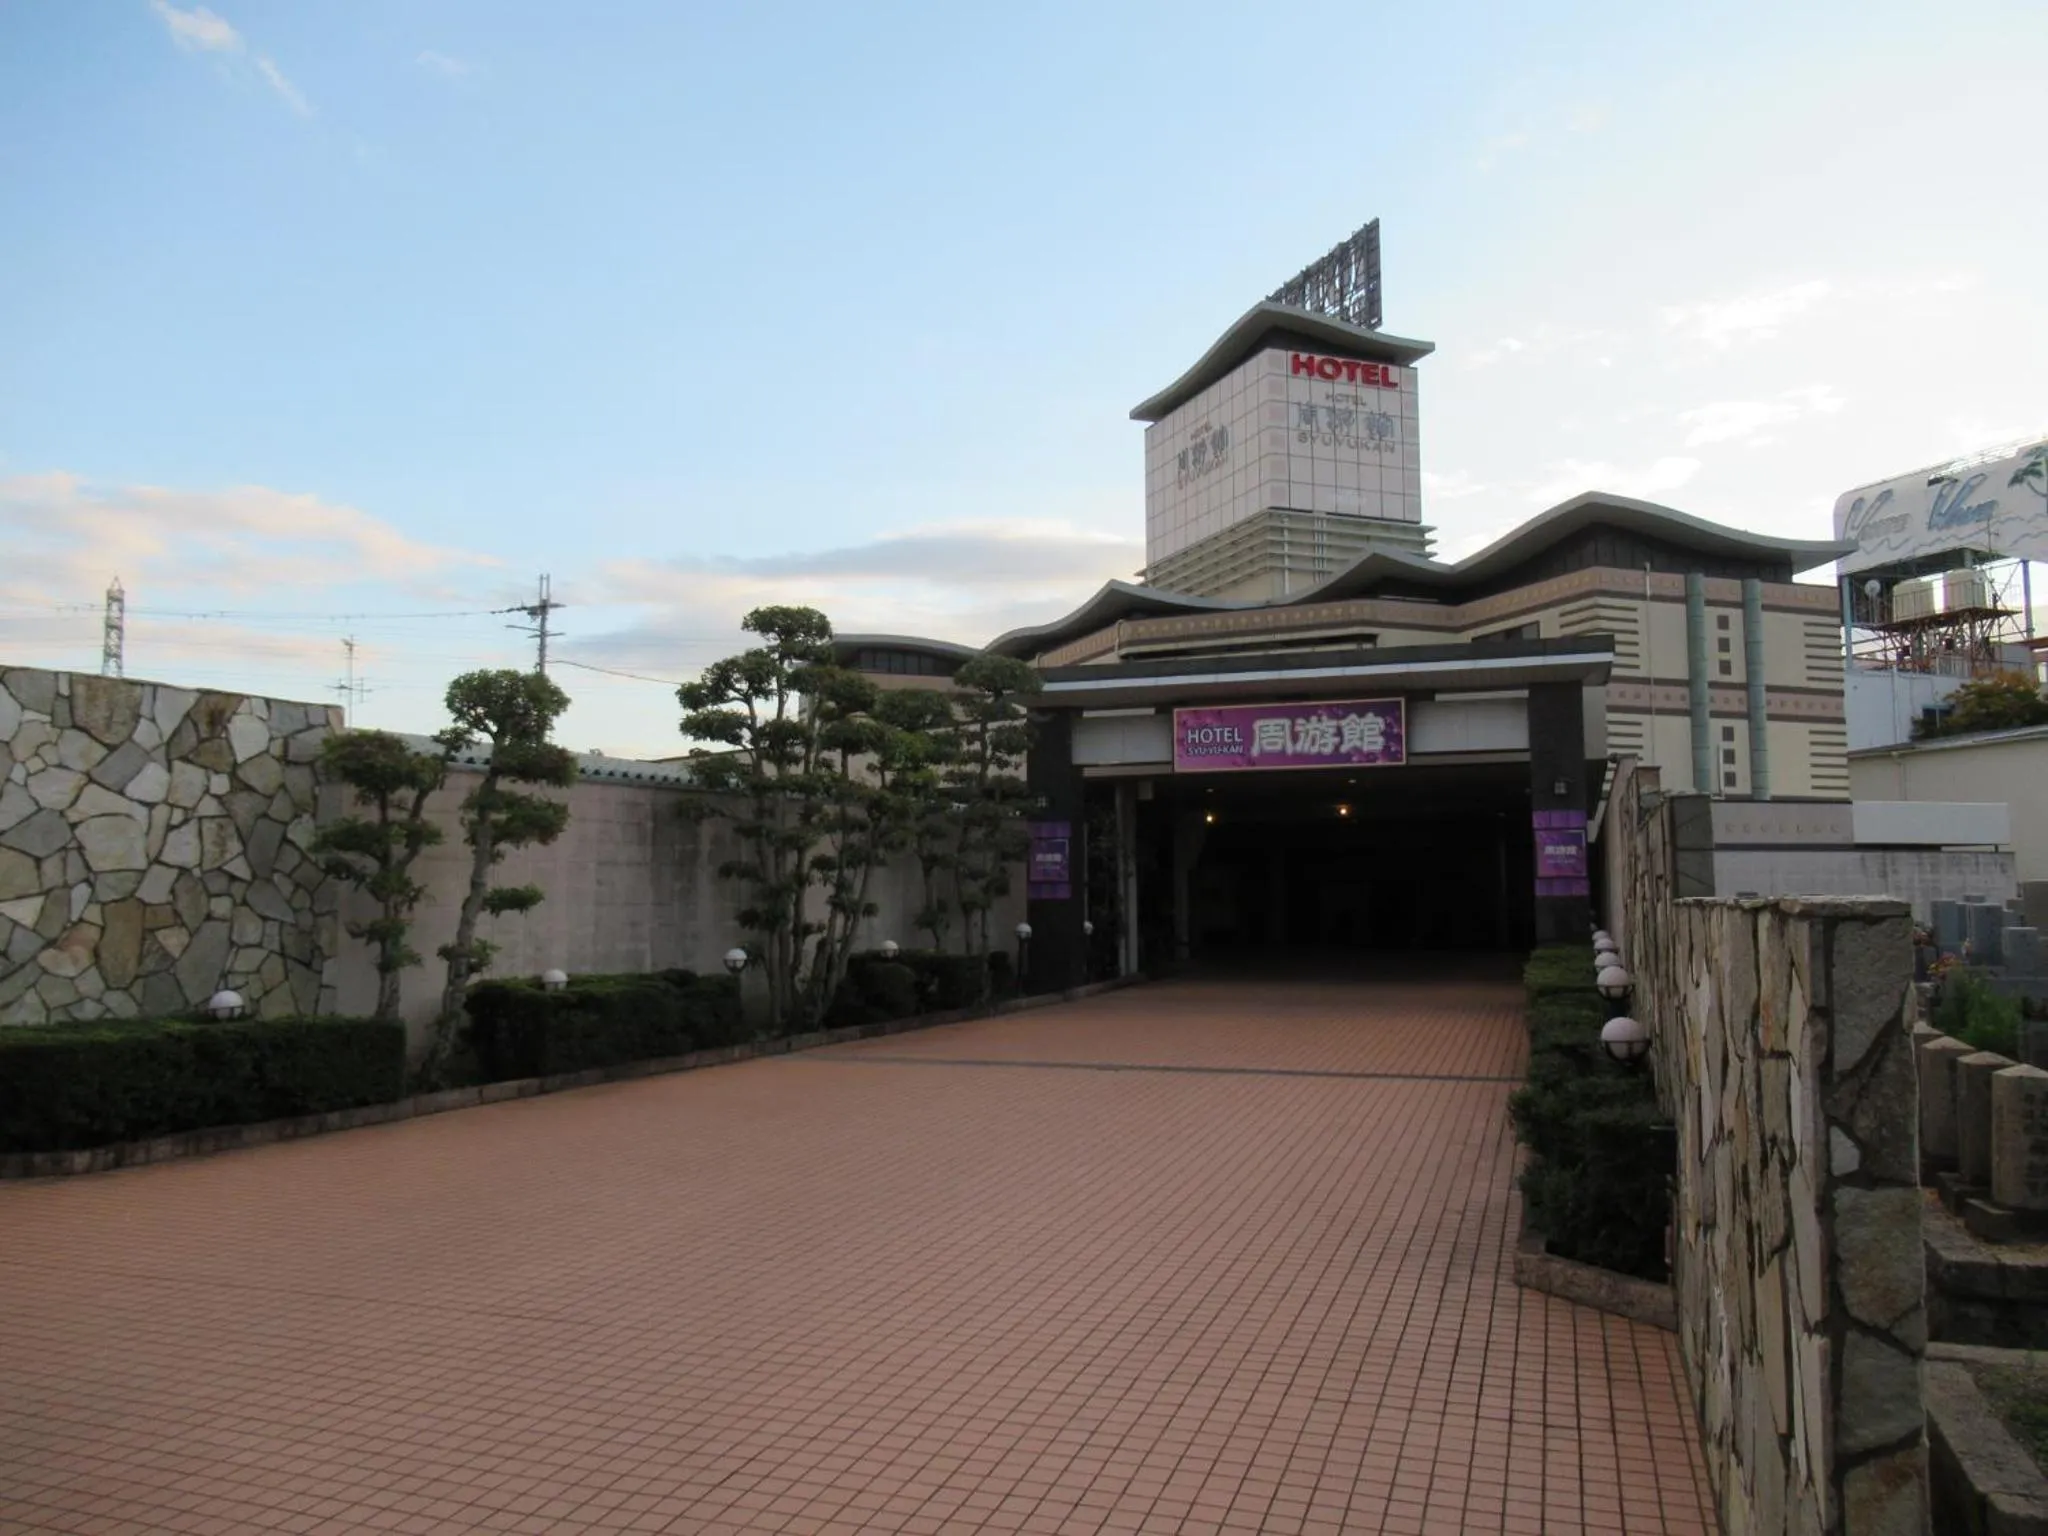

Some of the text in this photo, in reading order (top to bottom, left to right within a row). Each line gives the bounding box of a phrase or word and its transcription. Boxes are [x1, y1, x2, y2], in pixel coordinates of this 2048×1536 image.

[1291, 353, 1399, 388] HOTEL
[1187, 727, 1244, 744] HOTEL
[1252, 712, 1386, 757] 周游館
